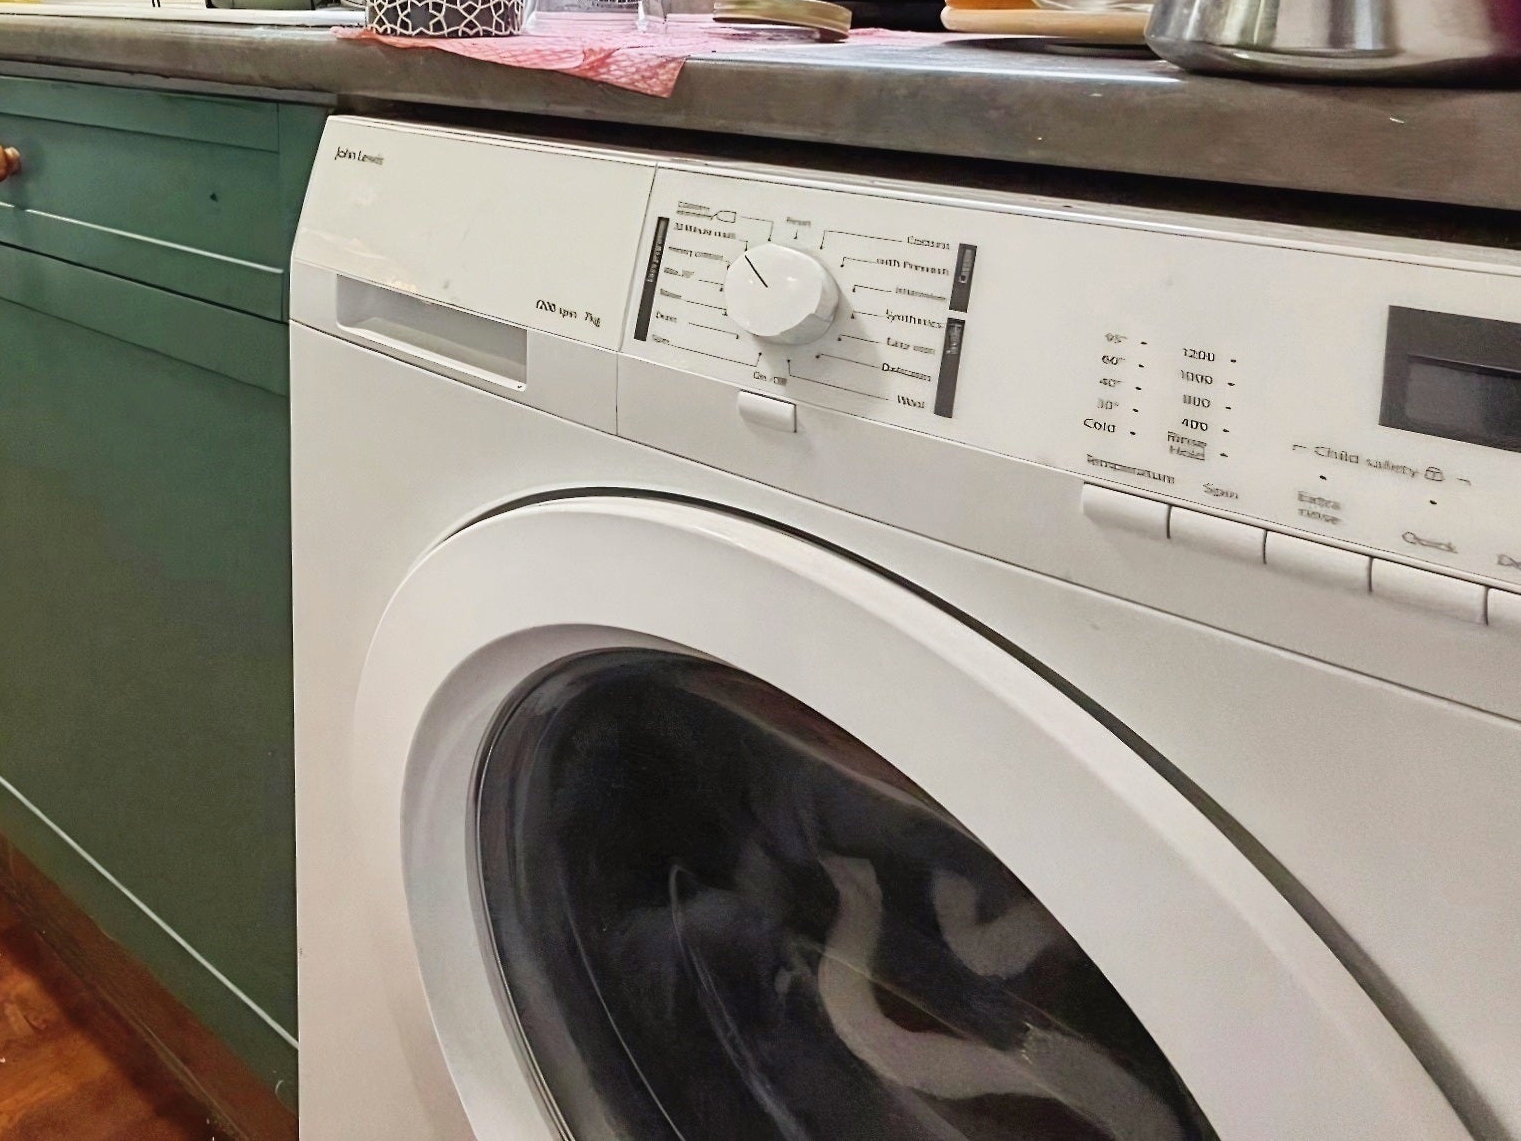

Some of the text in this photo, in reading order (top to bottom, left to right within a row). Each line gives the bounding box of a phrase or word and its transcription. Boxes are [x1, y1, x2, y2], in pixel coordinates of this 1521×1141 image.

[1182, 347, 1215, 362] 1200
[1180, 369, 1213, 385] 1000
[1083, 418, 1116, 433] Cold
[1314, 446, 1417, 478] Child safety
[1202, 482, 1239, 500] Spin
